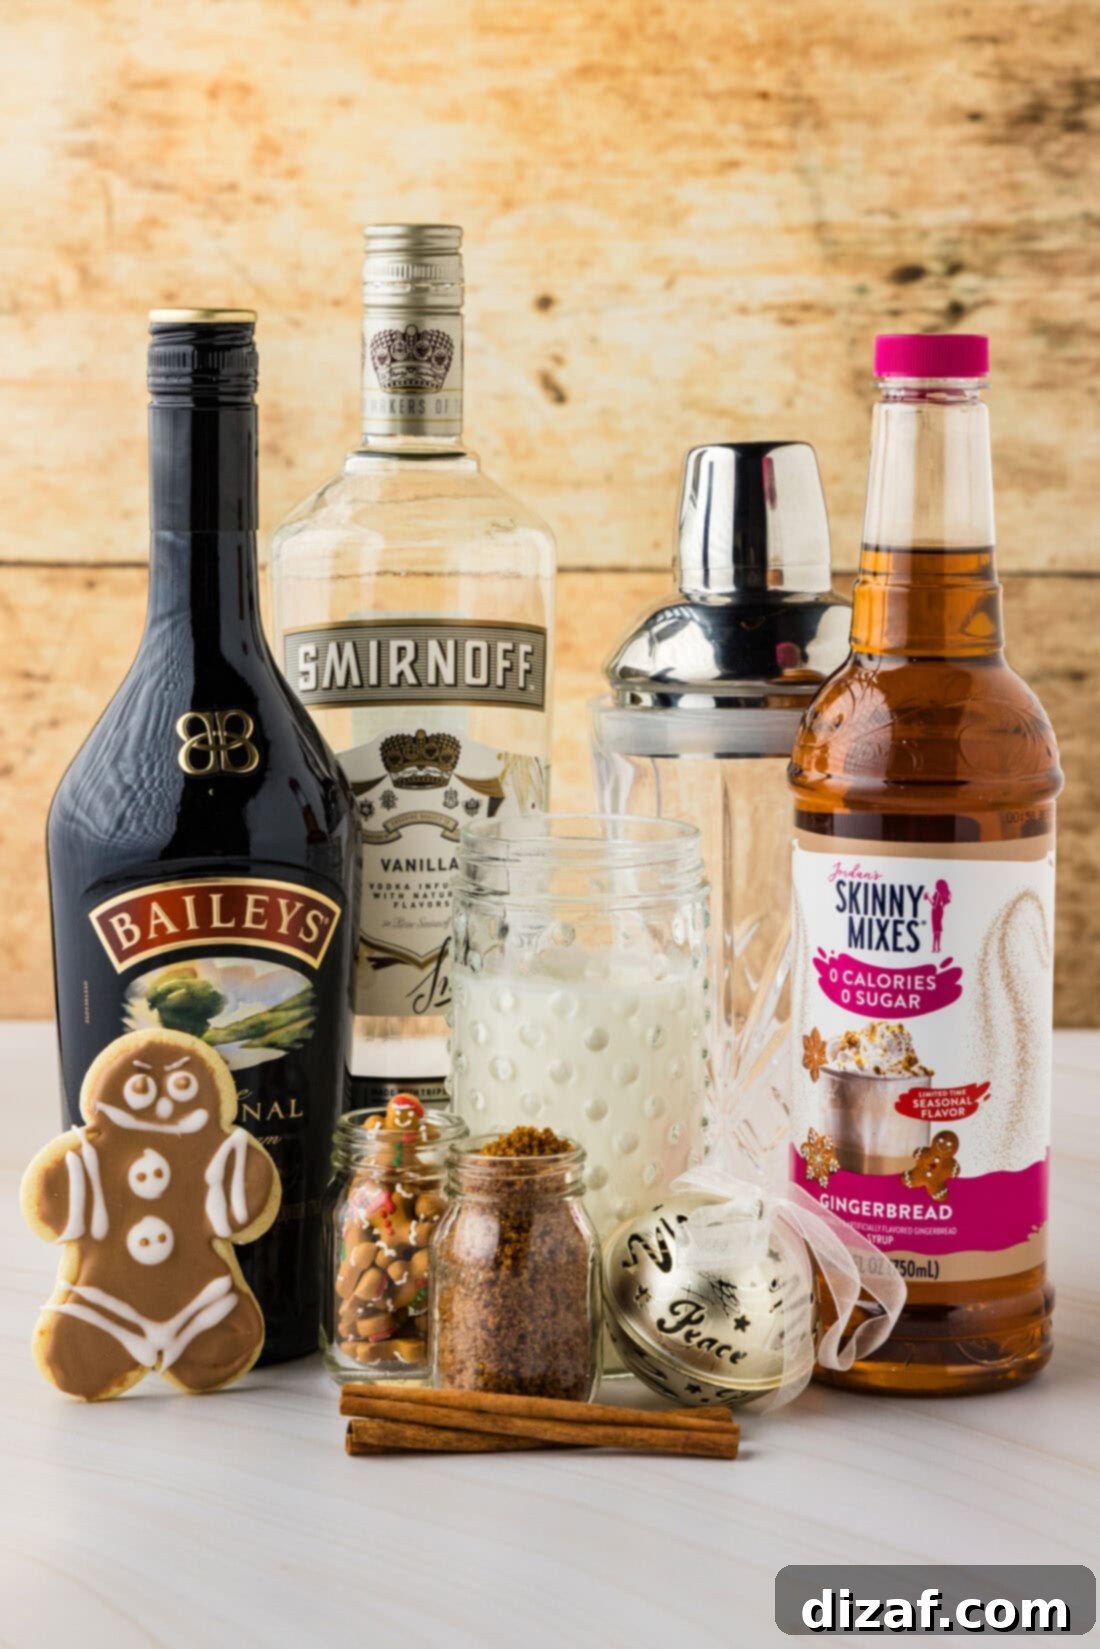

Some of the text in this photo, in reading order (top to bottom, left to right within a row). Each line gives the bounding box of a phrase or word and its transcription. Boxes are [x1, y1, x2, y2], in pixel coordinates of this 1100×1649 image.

[299, 639, 535, 691] SMIRNOFF
[381, 857, 460, 873] VANILLA
[828, 862, 884, 882] Jordan's
[373, 891, 454, 900] WITH NATUR
[418, 882, 450, 890] INFU
[393, 900, 450, 909] FLAVORS
[835, 879, 925, 918] SKINNY
[109, 893, 325, 950] BAILEYS
[847, 916, 921, 953] MIXES
[829, 968, 937, 990] 0 CALORIES
[841, 988, 921, 1009] 0 SUGAR
[912, 1096, 974, 1109] SEASONAL
[918, 1090, 948, 1098] LIMITED
[242, 1099, 304, 1122] NAL
[921, 1107, 965, 1119] FLAVOR
[819, 1193, 954, 1220] GINGERBREAD
[867, 1233, 894, 1246] SYRUP
[656, 1300, 748, 1365] Peace
